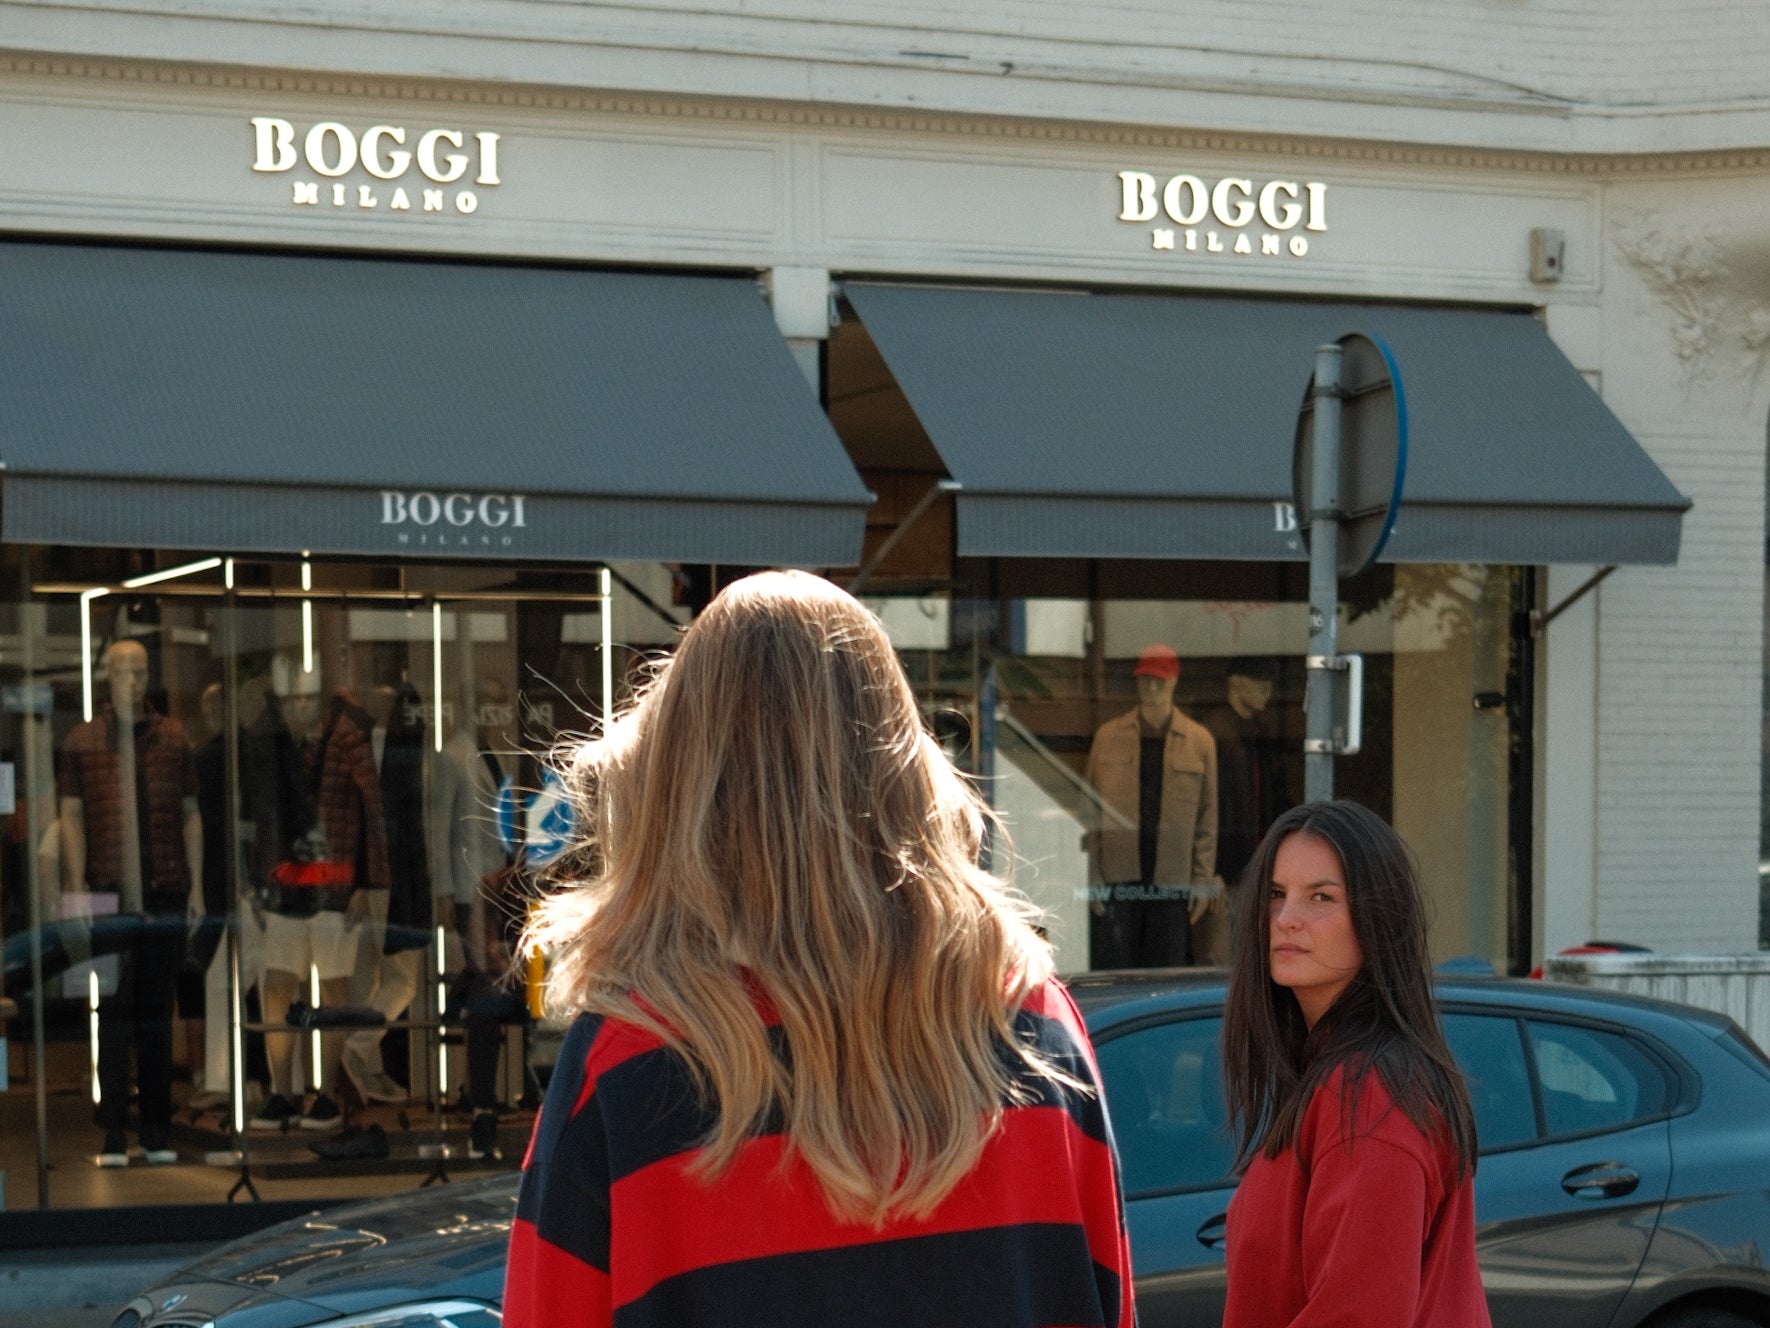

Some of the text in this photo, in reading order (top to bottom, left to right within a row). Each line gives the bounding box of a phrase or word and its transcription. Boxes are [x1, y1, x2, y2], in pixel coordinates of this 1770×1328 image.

[250, 117, 501, 185] BOGGI
[293, 181, 478, 214] MILANO
[1118, 171, 1328, 231] BOGGI
[1152, 228, 1309, 257] MILANO
[381, 491, 527, 527] BOGGI
[398, 533, 512, 546] MILANO
[1073, 883, 1221, 902] NEW COLLECTN
